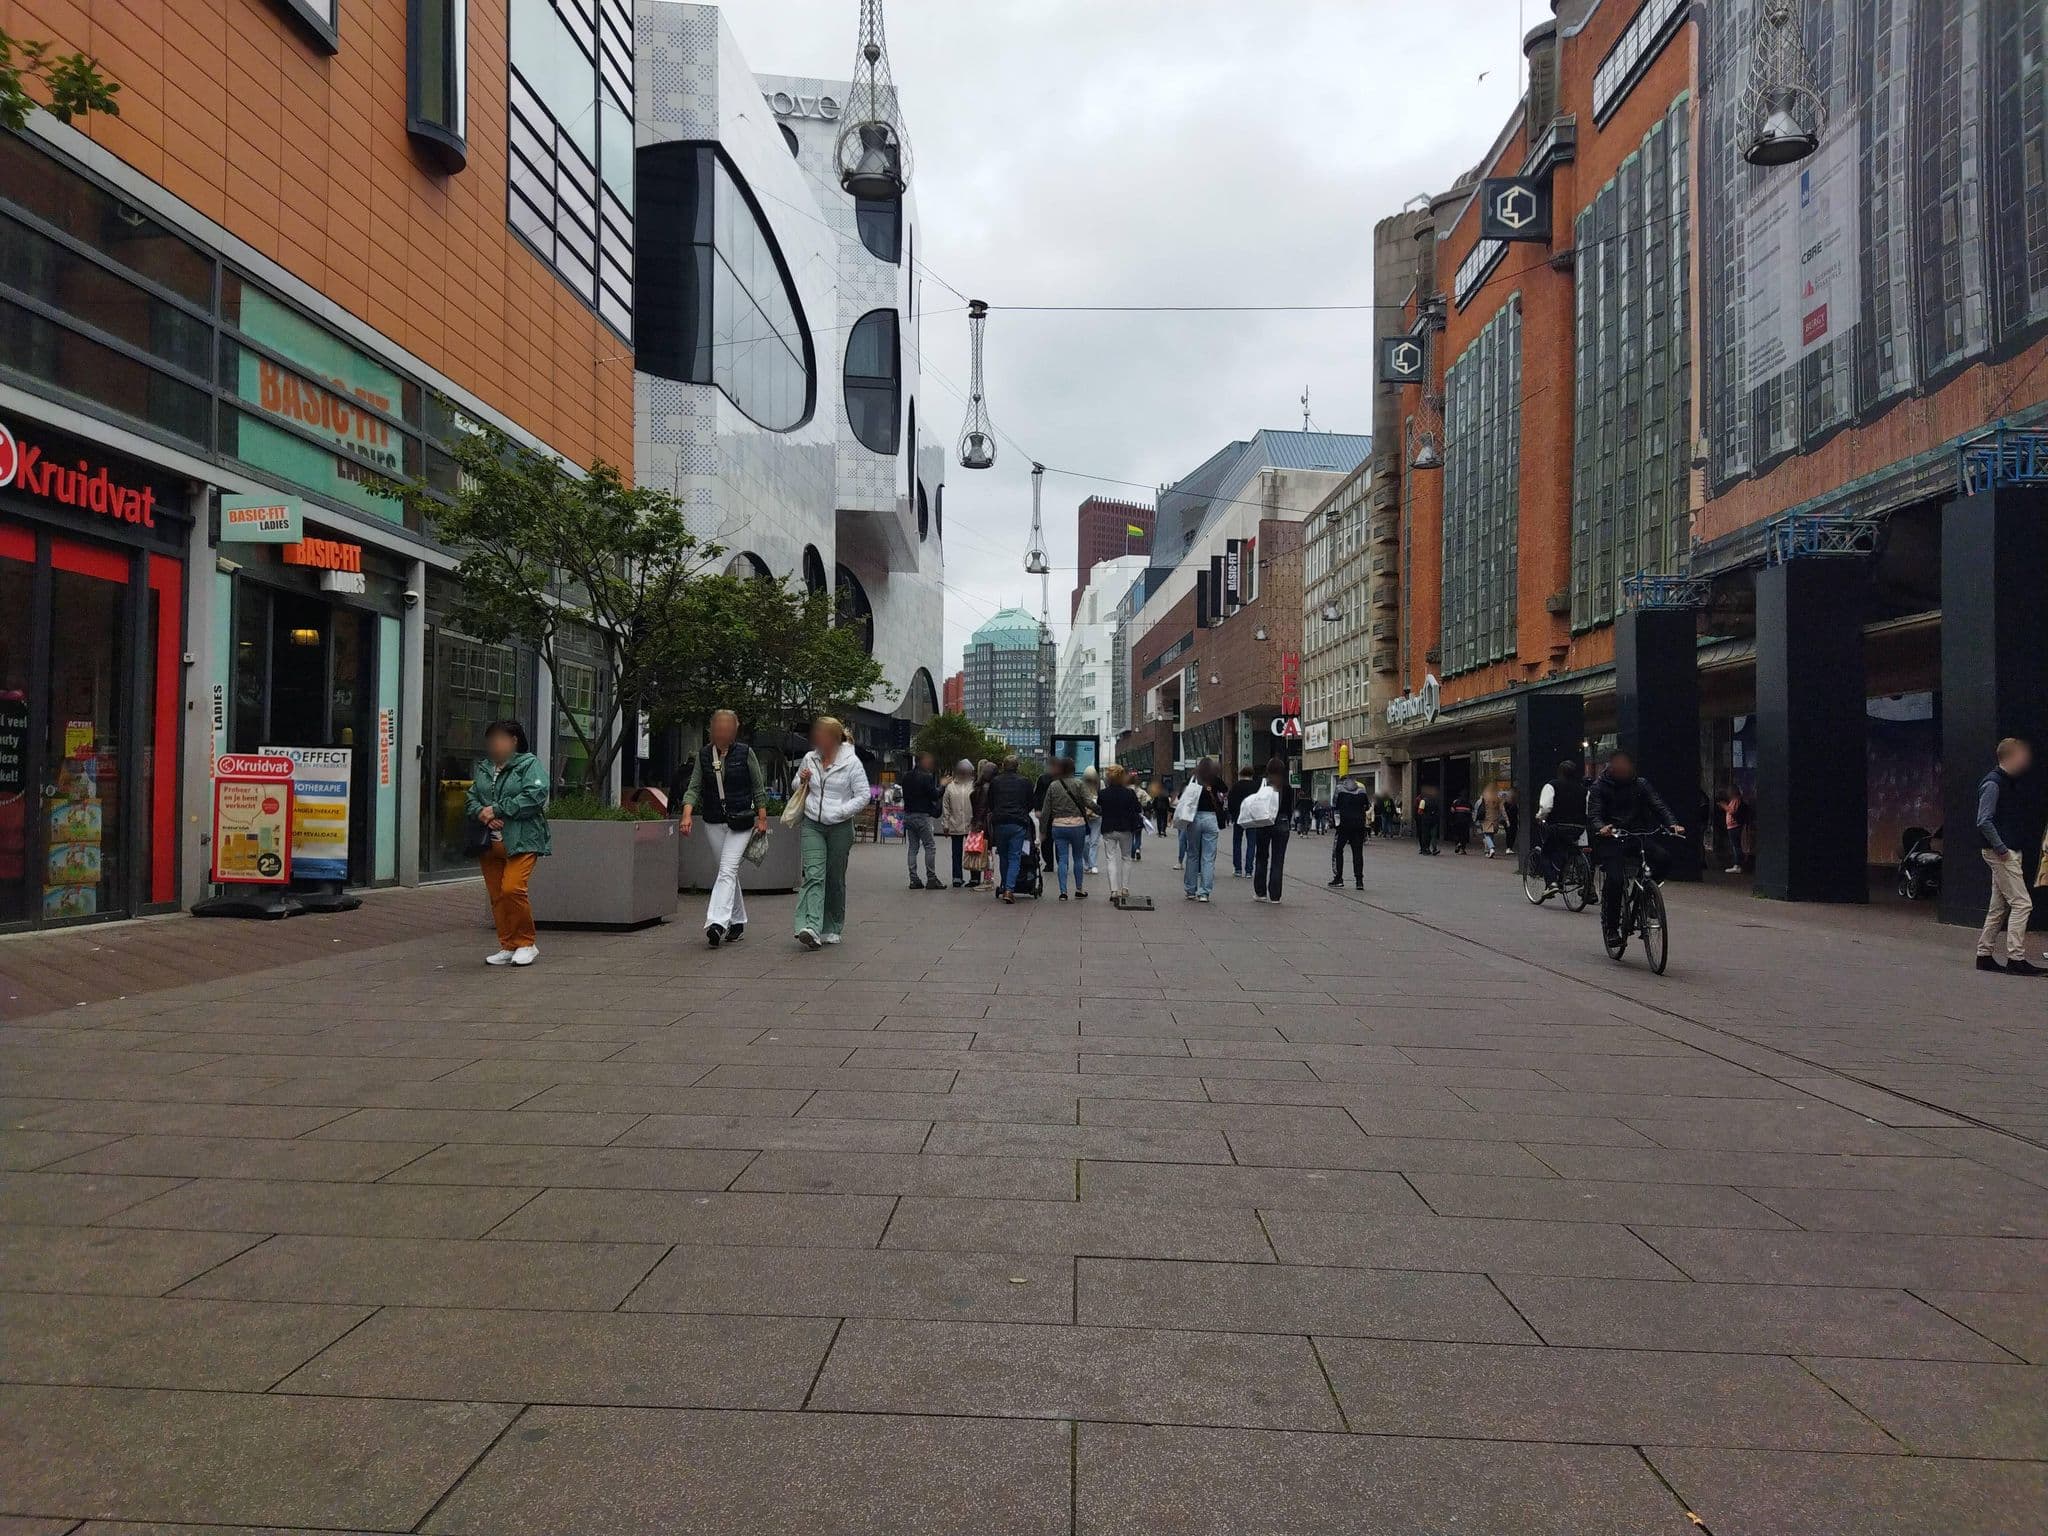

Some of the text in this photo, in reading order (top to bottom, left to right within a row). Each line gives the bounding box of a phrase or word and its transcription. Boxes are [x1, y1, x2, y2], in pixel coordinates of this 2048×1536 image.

[1801, 240, 1823, 264] CBRE
[16, 440, 156, 529] Kruidvat
[260, 519, 289, 531] LADIES
[334, 571, 366, 594] LADIES
[1282, 651, 1300, 737] HEMA
[214, 684, 223, 731] LADIES
[8, 717, 28, 728] veel
[235, 759, 289, 773] Kruidvat
